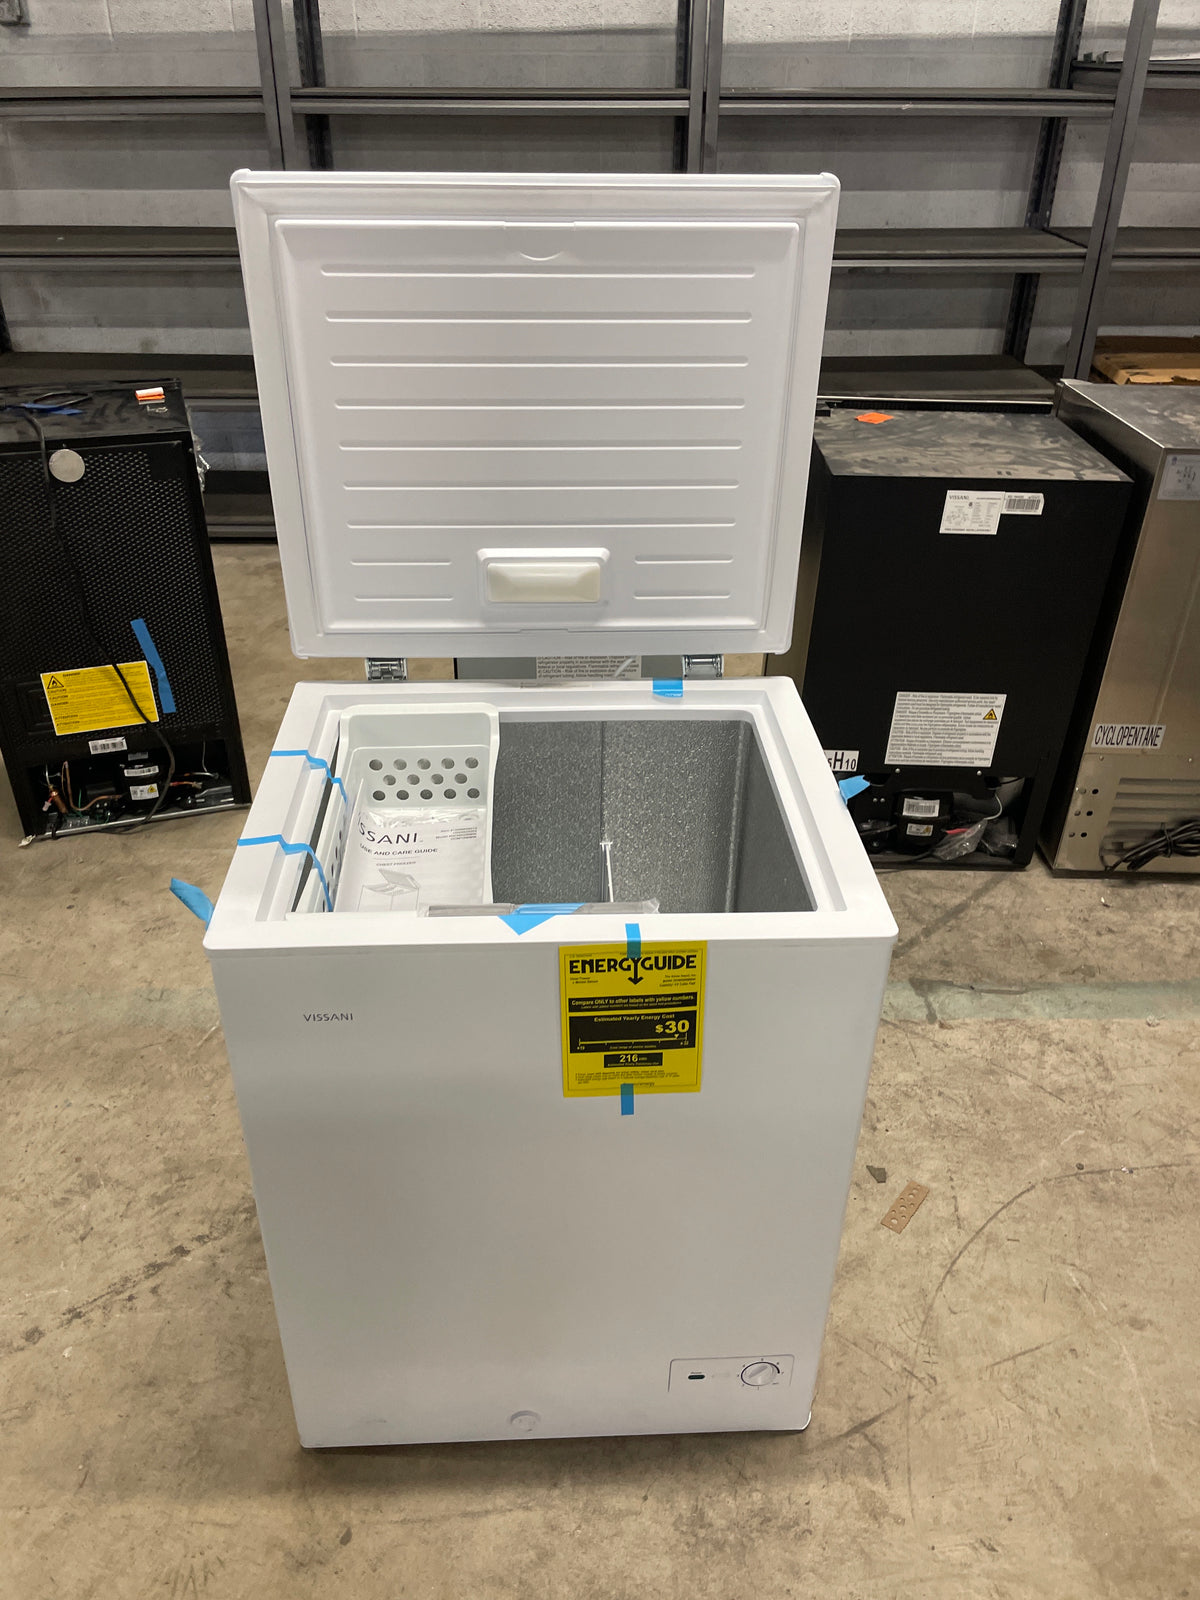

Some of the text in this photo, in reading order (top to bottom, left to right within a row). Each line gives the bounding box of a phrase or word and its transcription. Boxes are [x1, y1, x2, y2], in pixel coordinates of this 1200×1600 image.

[1094, 726, 1162, 746] CYCLOPENTANE
[304, 1013, 353, 1021] VISSANI
[656, 1020, 690, 1034] $30
[620, 1054, 638, 1062] 216
